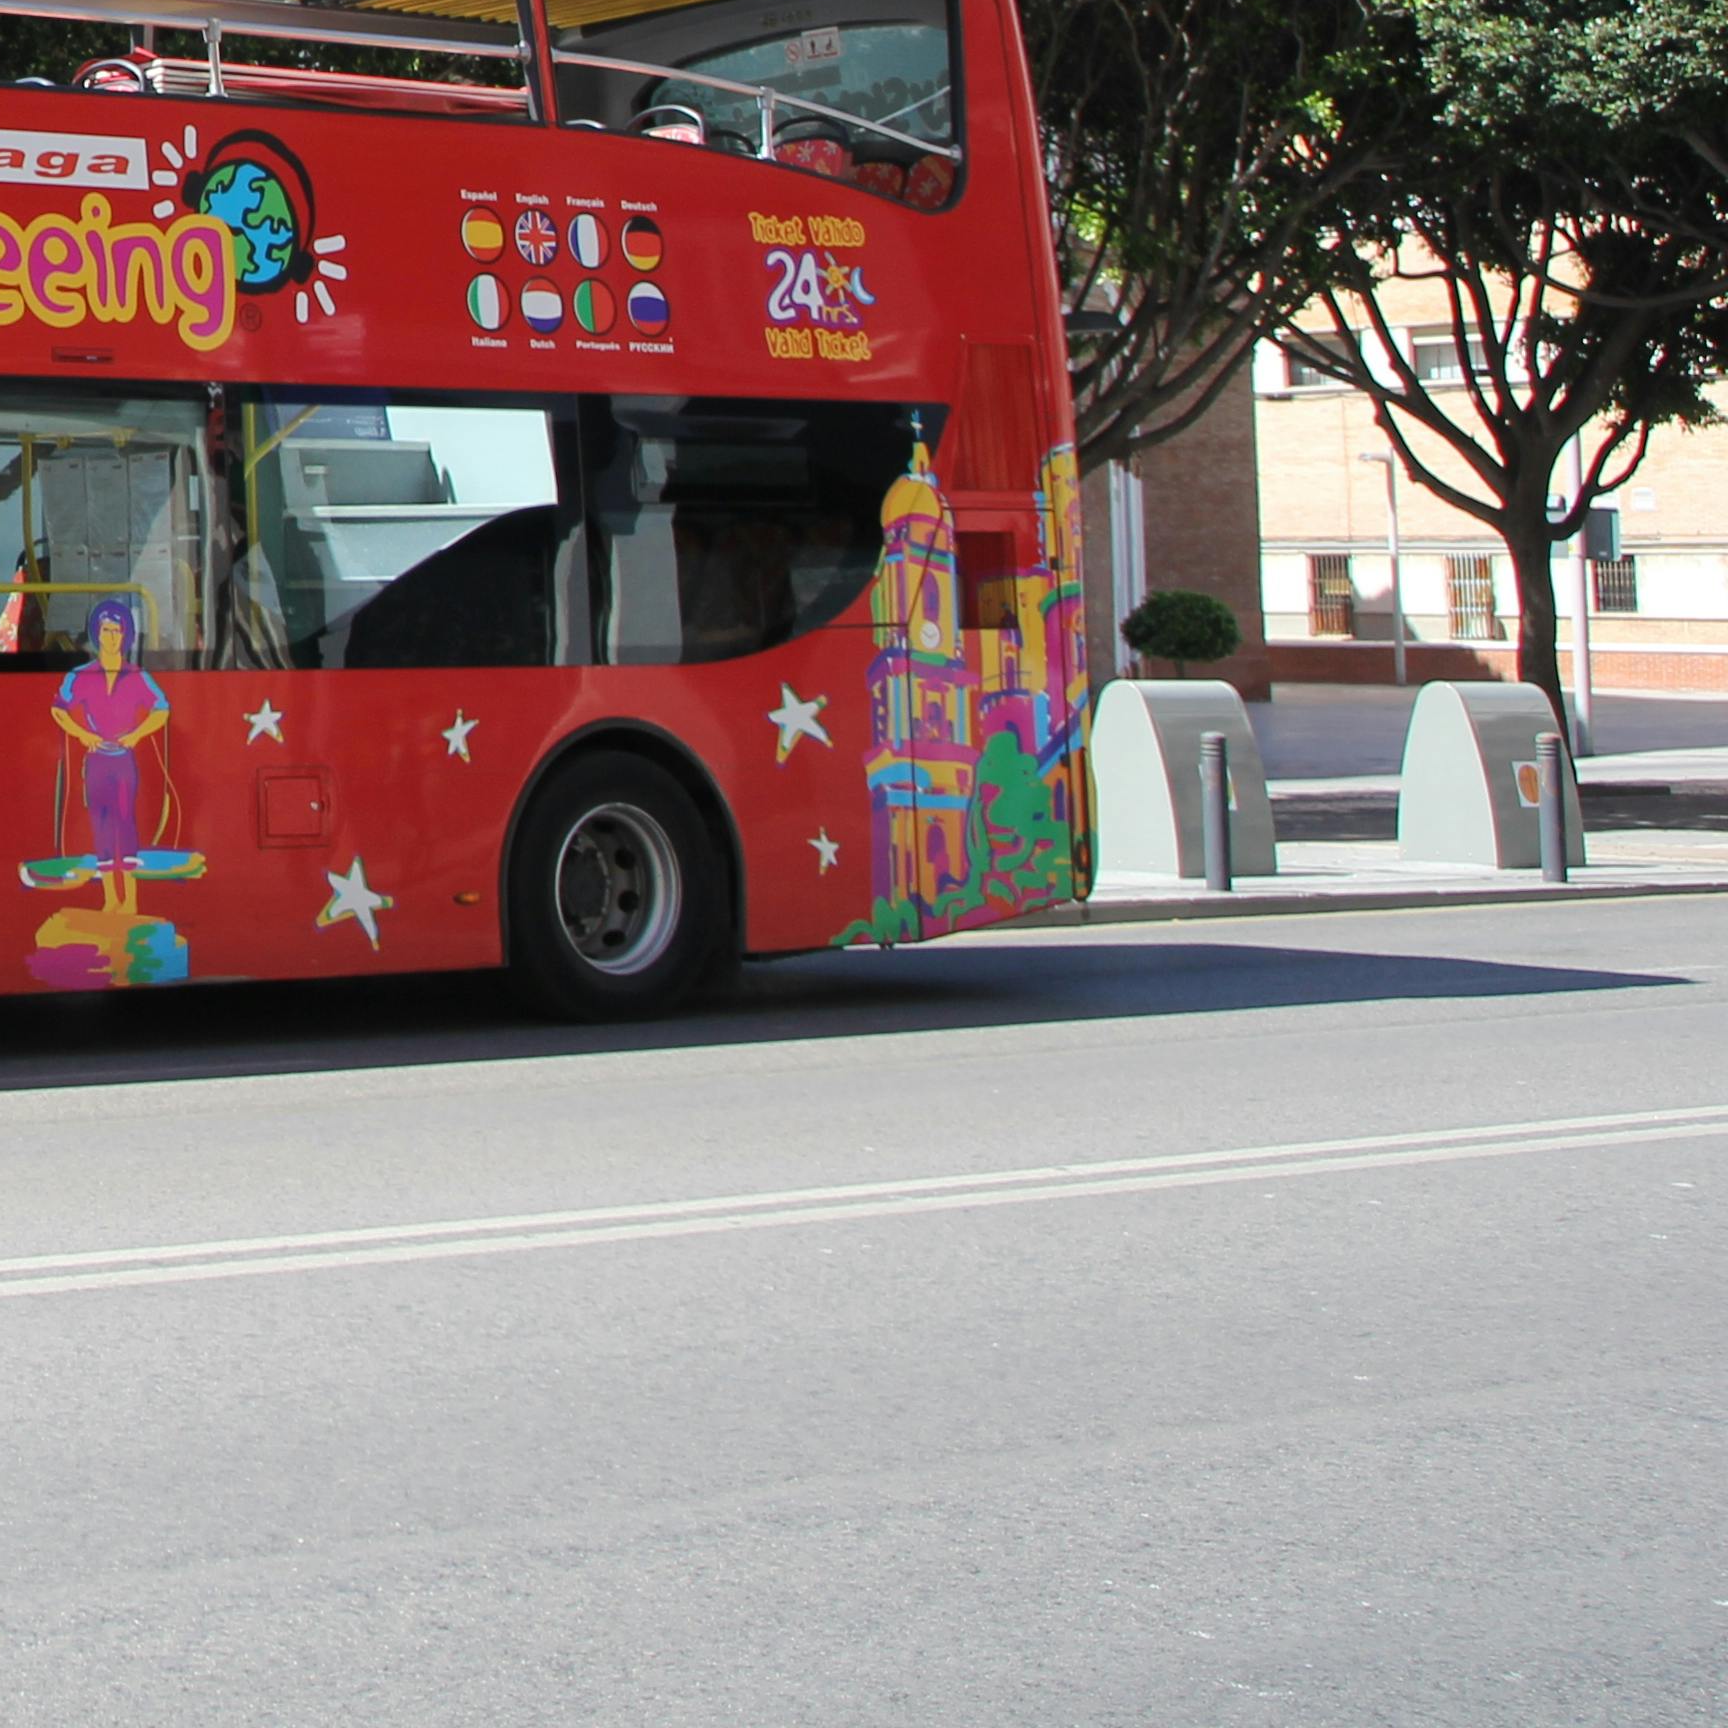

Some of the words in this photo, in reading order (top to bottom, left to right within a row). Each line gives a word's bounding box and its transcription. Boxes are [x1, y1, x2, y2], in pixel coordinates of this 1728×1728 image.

[460, 189, 498, 202] Español
[515, 192, 549, 206] English
[566, 196, 605, 209] Français
[621, 200, 658, 212] Deutsch
[748, 211, 807, 246] Ticket
[766, 250, 824, 320] 24
[471, 336, 508, 348] Italiano
[530, 339, 556, 349] Dutch
[765, 327, 814, 358] Valid
[814, 328, 872, 361] Ticket
